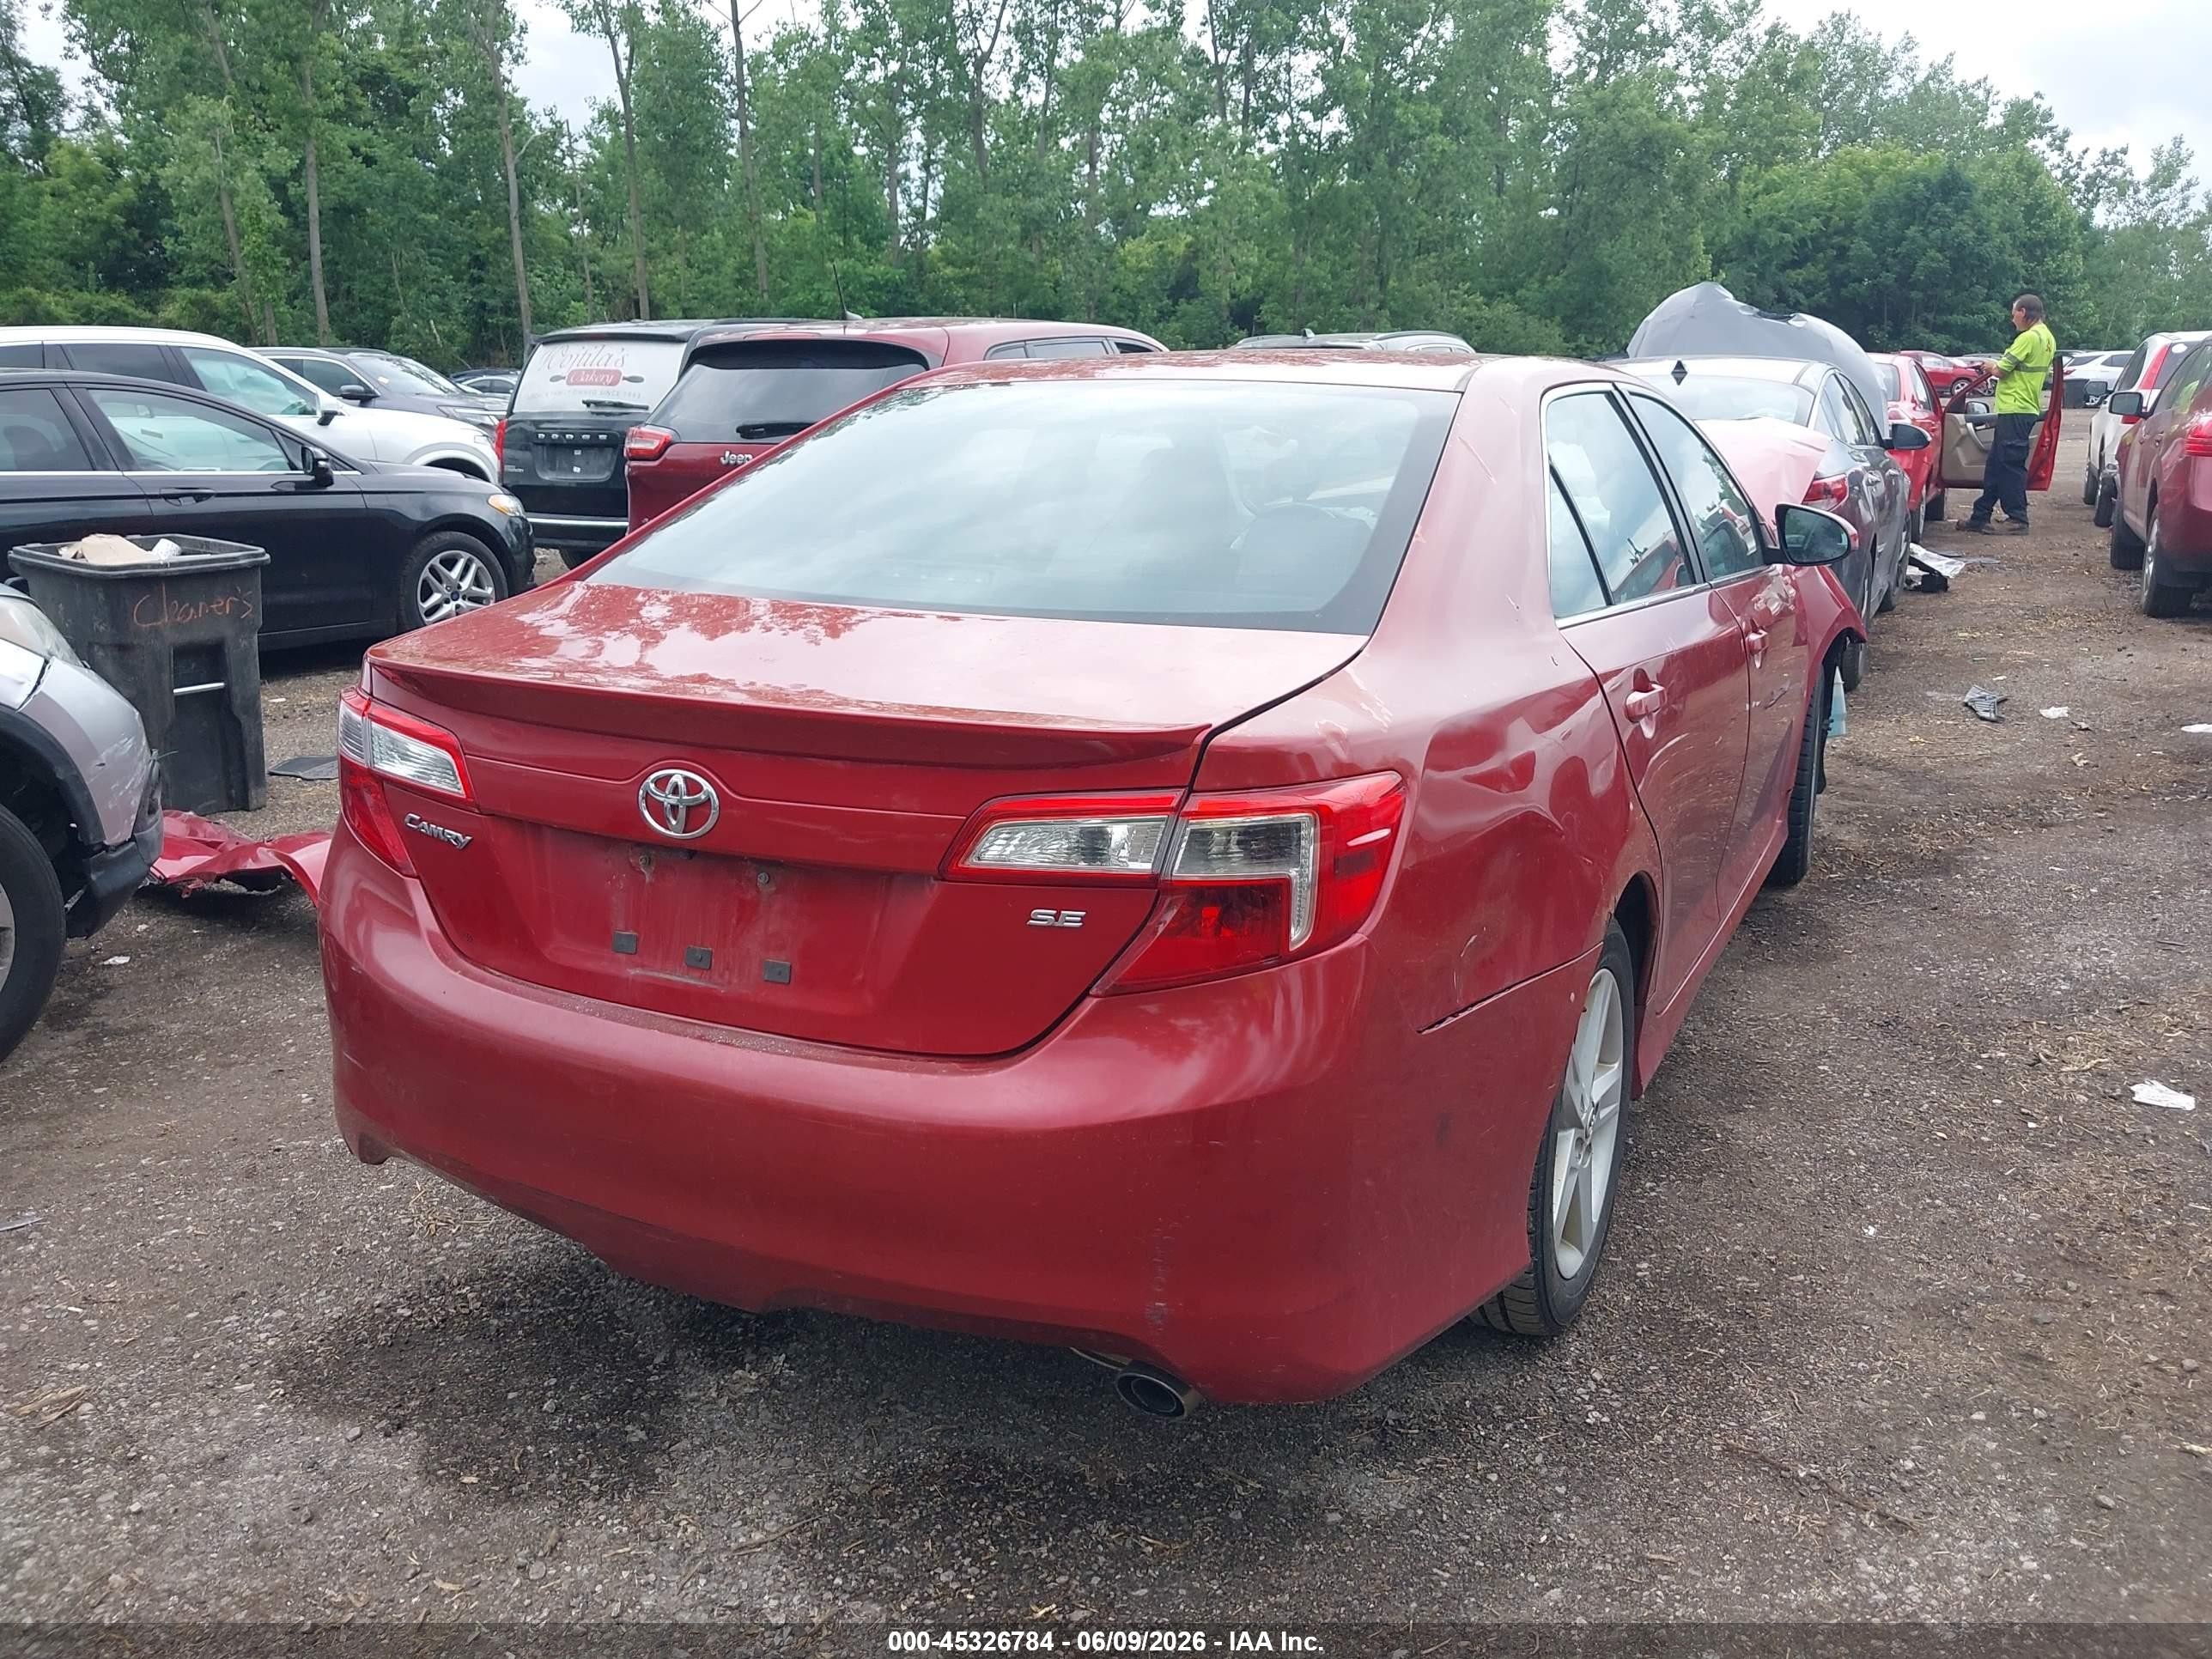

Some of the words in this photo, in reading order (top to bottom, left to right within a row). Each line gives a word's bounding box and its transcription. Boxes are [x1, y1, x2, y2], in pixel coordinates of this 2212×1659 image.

[720, 450, 753, 465] Jeep
[404, 812, 473, 850] CAMRY
[1026, 908, 1086, 927] SE
